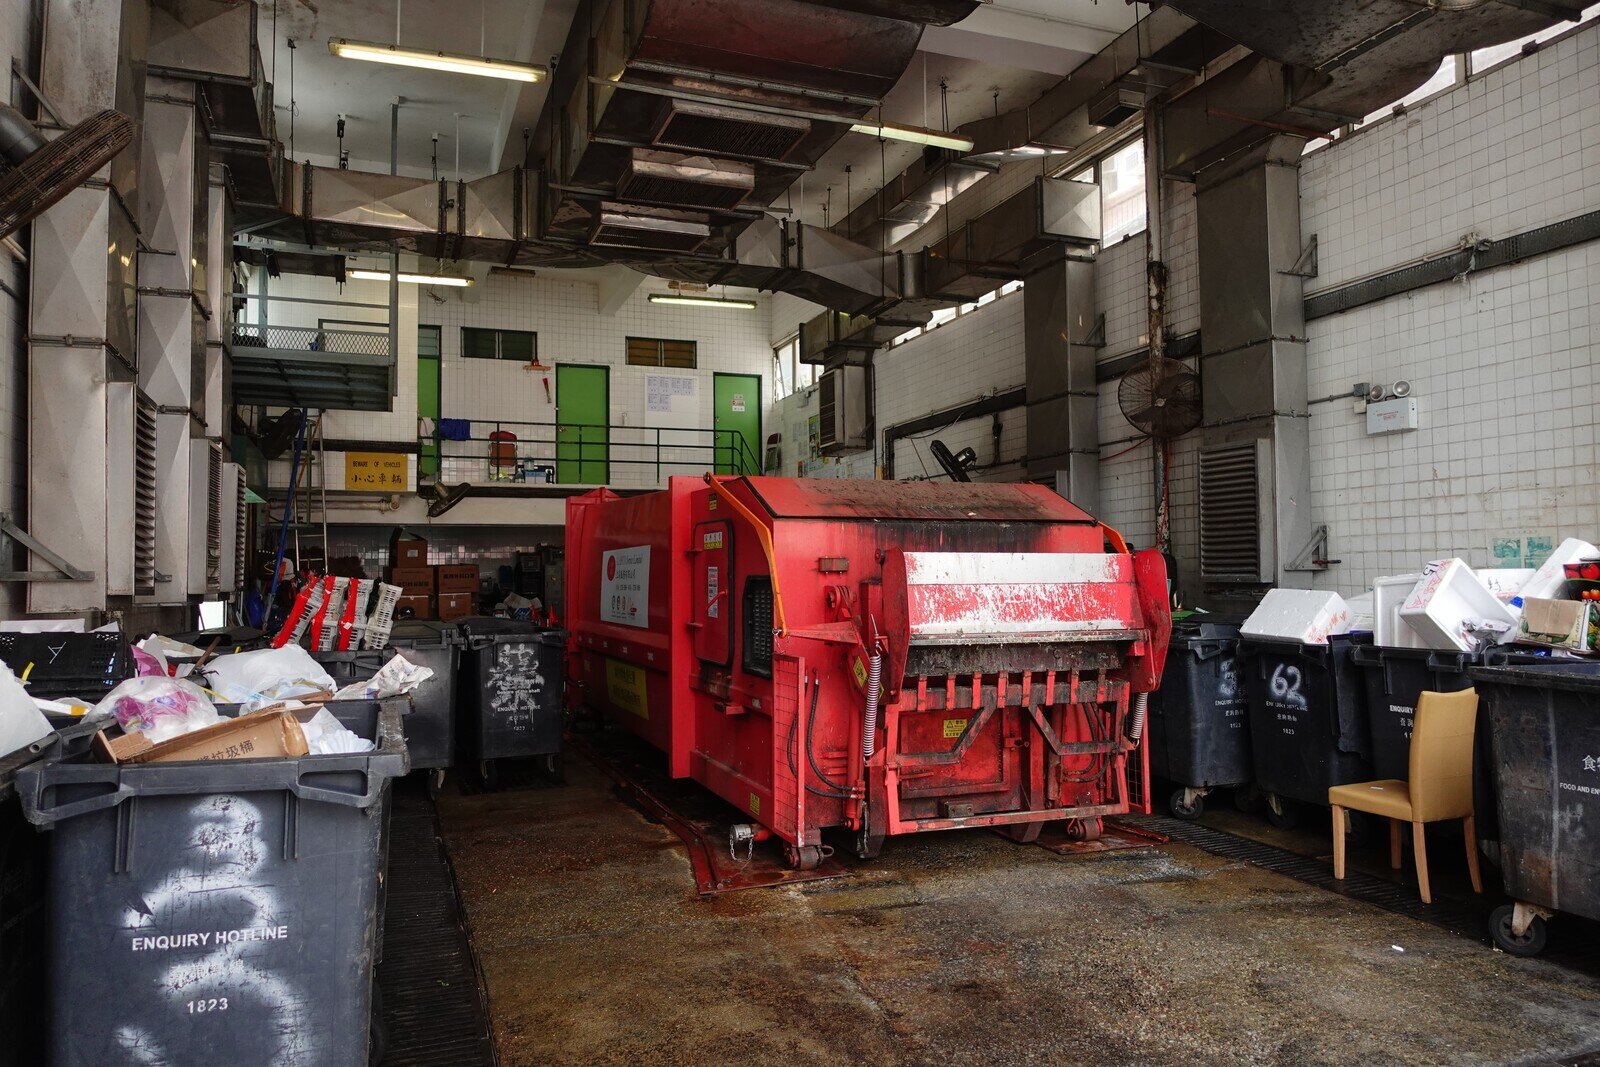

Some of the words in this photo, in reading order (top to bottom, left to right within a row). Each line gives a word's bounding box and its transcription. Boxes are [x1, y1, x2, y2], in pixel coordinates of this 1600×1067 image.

[352, 460, 368, 468] BEWARE
[351, 472, 402, 485] 小心車輛
[1270, 662, 1306, 704] 62
[1389, 704, 1413, 714] ENQUIRY
[1559, 782, 1576, 791] FOOD
[1577, 785, 1590, 793] AND
[131, 932, 210, 953] ENQUIRY
[215, 926, 288, 945] HOTLINE
[186, 997, 229, 1014] 1823
